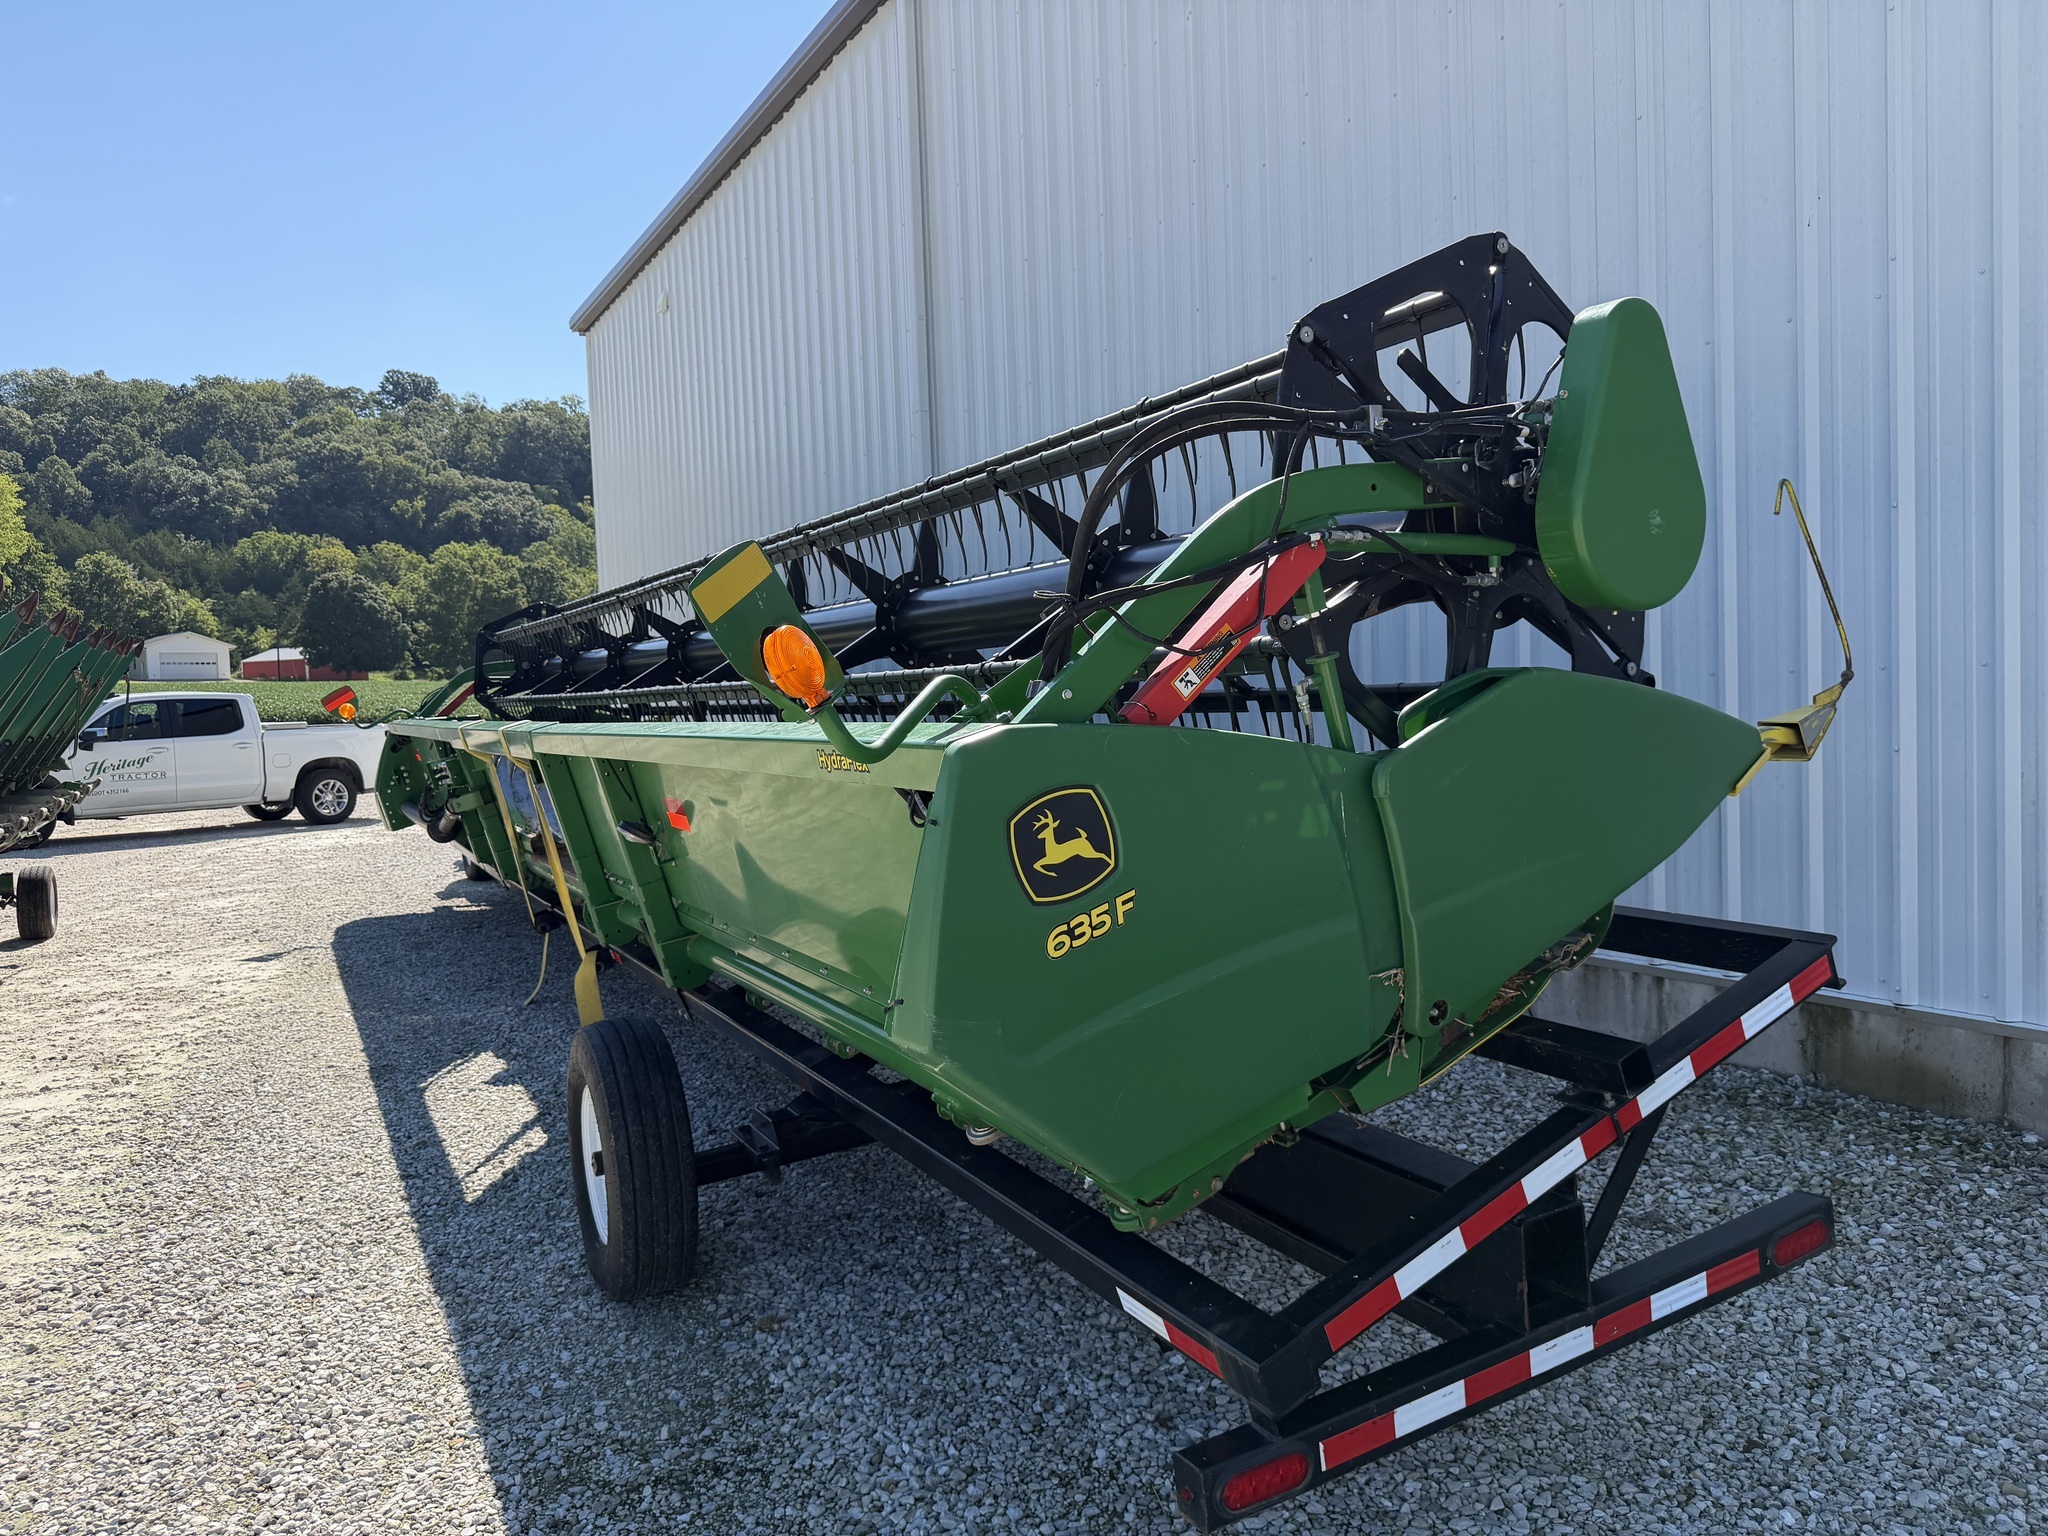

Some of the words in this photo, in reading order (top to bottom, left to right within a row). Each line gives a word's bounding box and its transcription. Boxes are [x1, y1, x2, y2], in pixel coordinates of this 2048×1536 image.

[83, 754, 155, 781] Heritage
[110, 772, 167, 781] TRACTOR
[106, 788, 130, 796] 4352166
